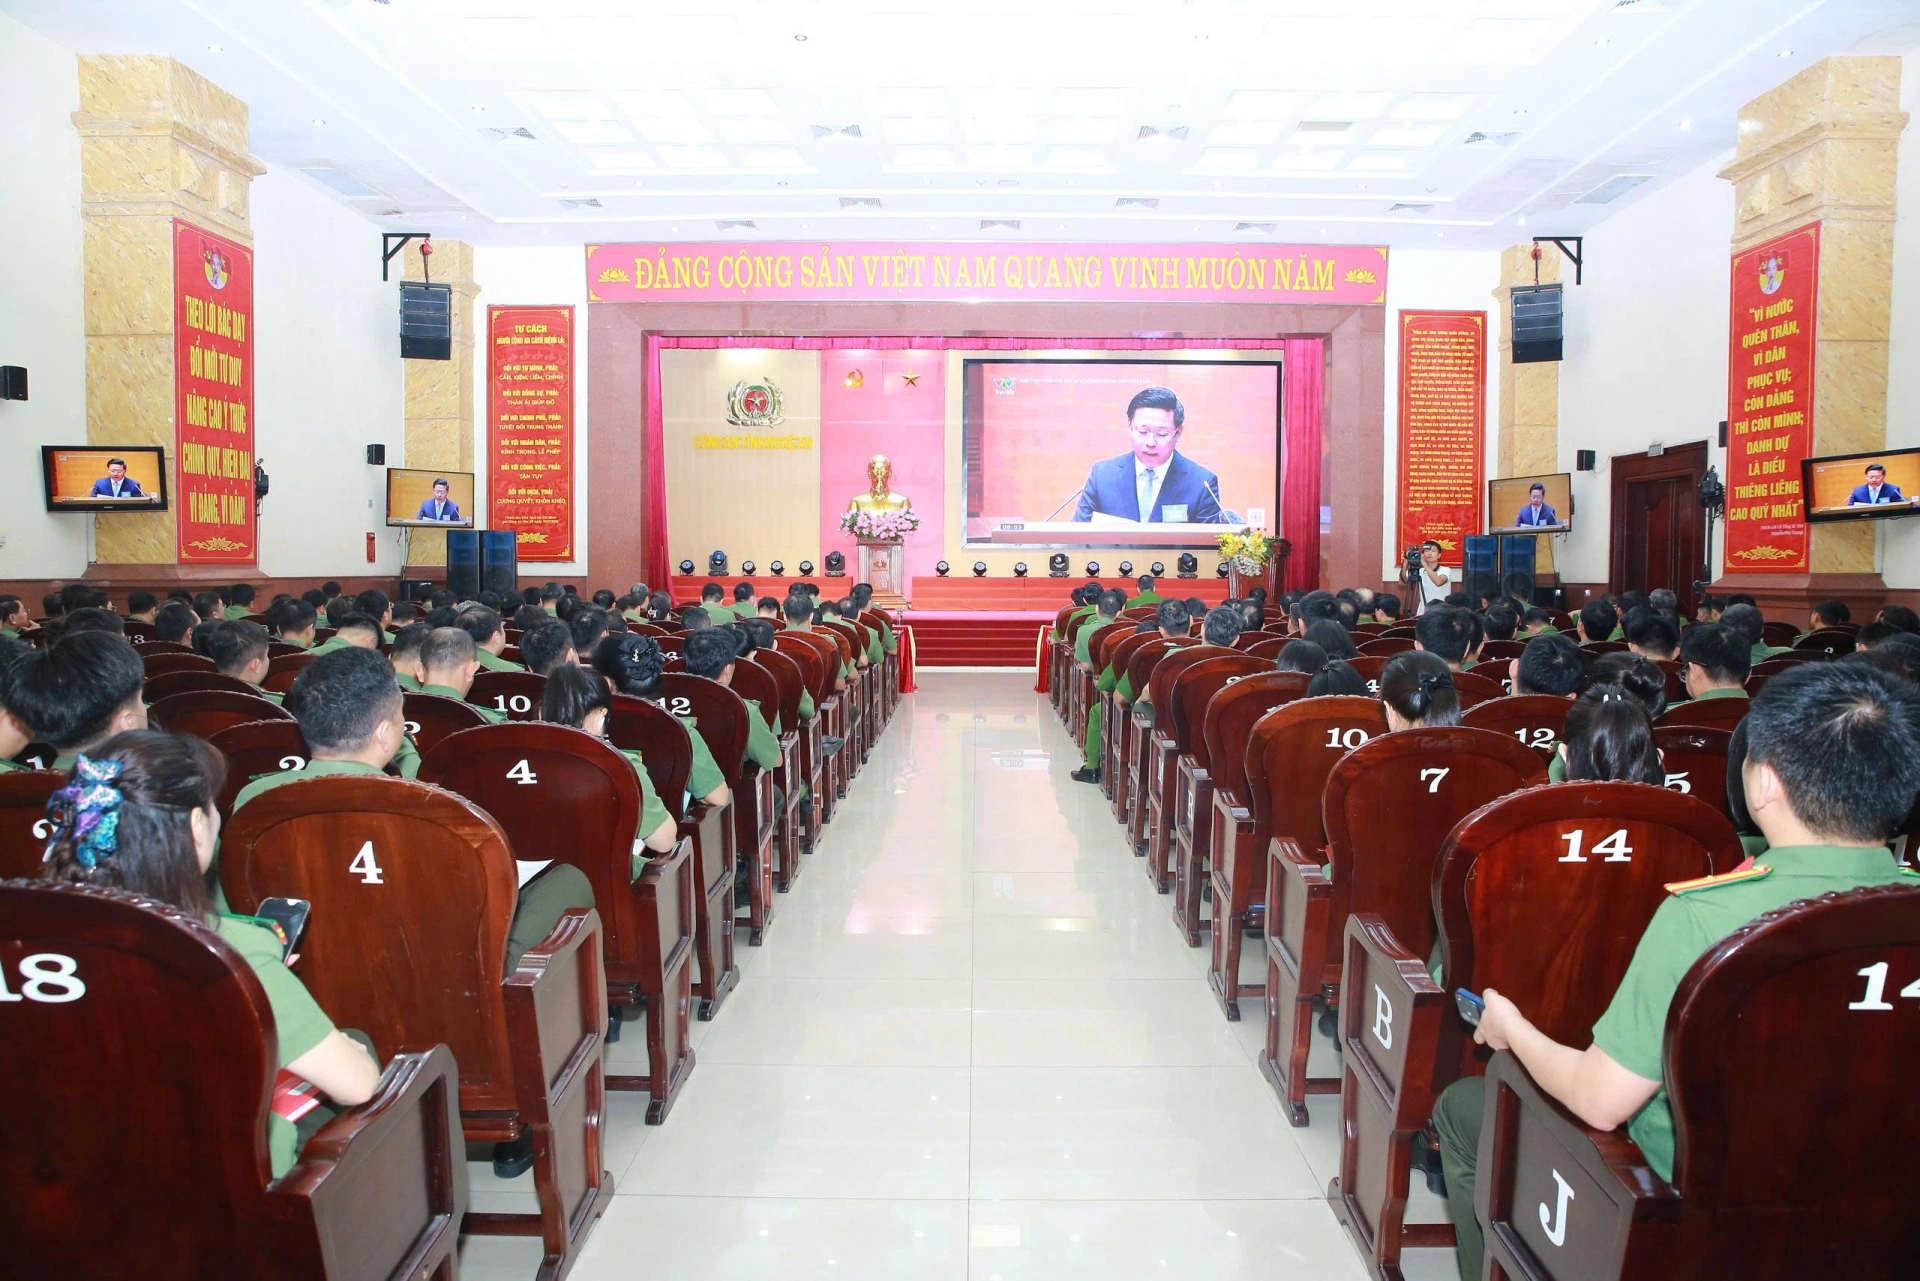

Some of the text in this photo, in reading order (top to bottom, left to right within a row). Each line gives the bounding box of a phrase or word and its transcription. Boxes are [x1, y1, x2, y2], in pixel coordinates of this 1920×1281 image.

[634, 246, 1336, 294] ĐẢNG CỘNG SẢN VIỆT NAM QUANG VINH MUÔN NĂM
[1766, 298, 1793, 319] NƯỚC
[186, 295, 246, 348] THEO LỜI BÁC DẠY
[515, 324, 547, 333] TƯ CÁCH
[1742, 320, 1799, 348] QUÊN THÂN,
[190, 334, 242, 387] ĐỔI MỚI TƯ DUY
[1754, 346, 1786, 366] VÌ DÂN
[1747, 368, 1792, 390] PHỤC VỤ;
[187, 388, 246, 434] NÂNG CAO Ý THỨC
[1744, 388, 1793, 412] CÒN ĐẢNG
[1735, 411, 1804, 435] THÌ CÒN MÌNH;
[1746, 434, 1790, 454] DANH DỰ
[183, 436, 250, 486] CHÍNH QUY, HIỆN ĐẠI
[1748, 456, 1785, 476] LÀ ĐIỀU
[1735, 479, 1799, 499] THIÊNG LIÊNG
[190, 483, 246, 528] VÌ ĐẢNG, VÌ DÂN!
[1730, 508, 1748, 520] CAO
[1750, 504, 1768, 520] QUÝ
[494, 695, 531, 712] 10
[1325, 727, 1369, 750] 10
[1514, 728, 1554, 749] 12
[506, 760, 537, 784] 4
[1420, 767, 1450, 793] 7
[1664, 772, 1691, 794] 5
[1558, 829, 1633, 862] 14
[348, 841, 383, 884] 4
[1372, 983, 1393, 1049] B
[1539, 1168, 1574, 1247] J
